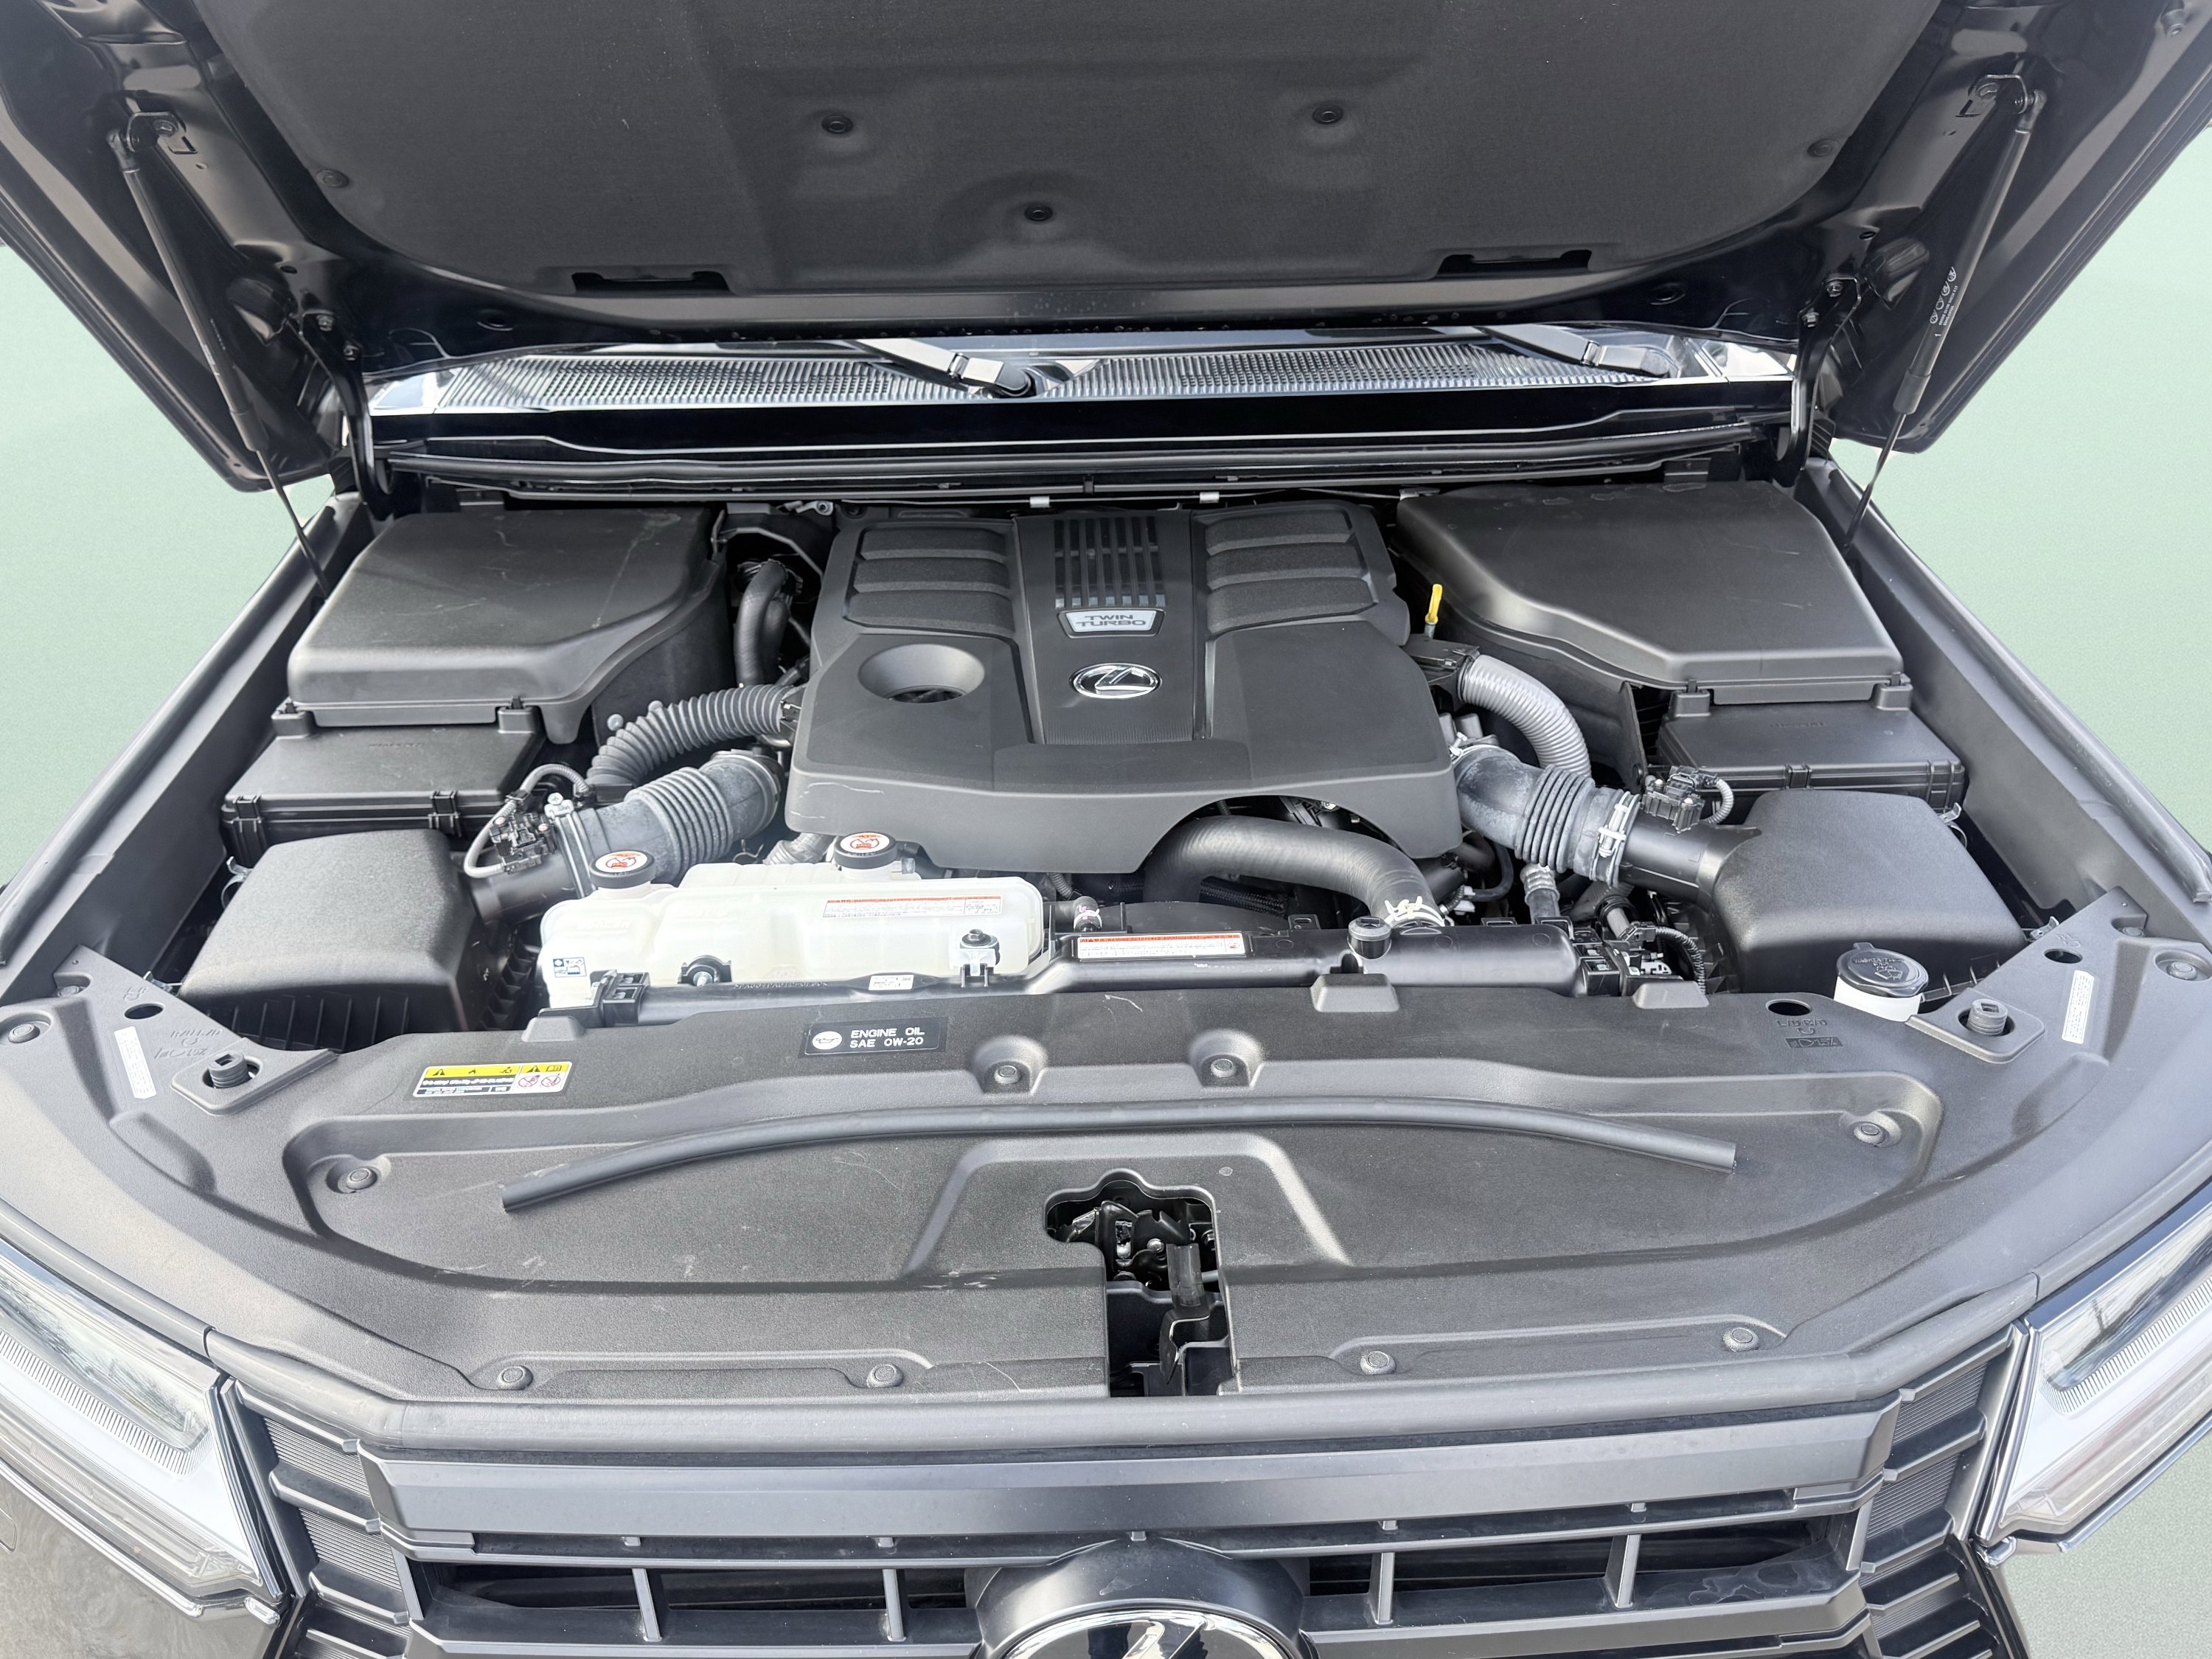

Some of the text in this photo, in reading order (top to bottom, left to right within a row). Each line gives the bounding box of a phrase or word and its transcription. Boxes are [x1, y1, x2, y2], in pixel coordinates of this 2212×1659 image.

[850, 1026, 925, 1039] ENGINE OIL
[849, 1037, 924, 1048] SAE 0W-20
